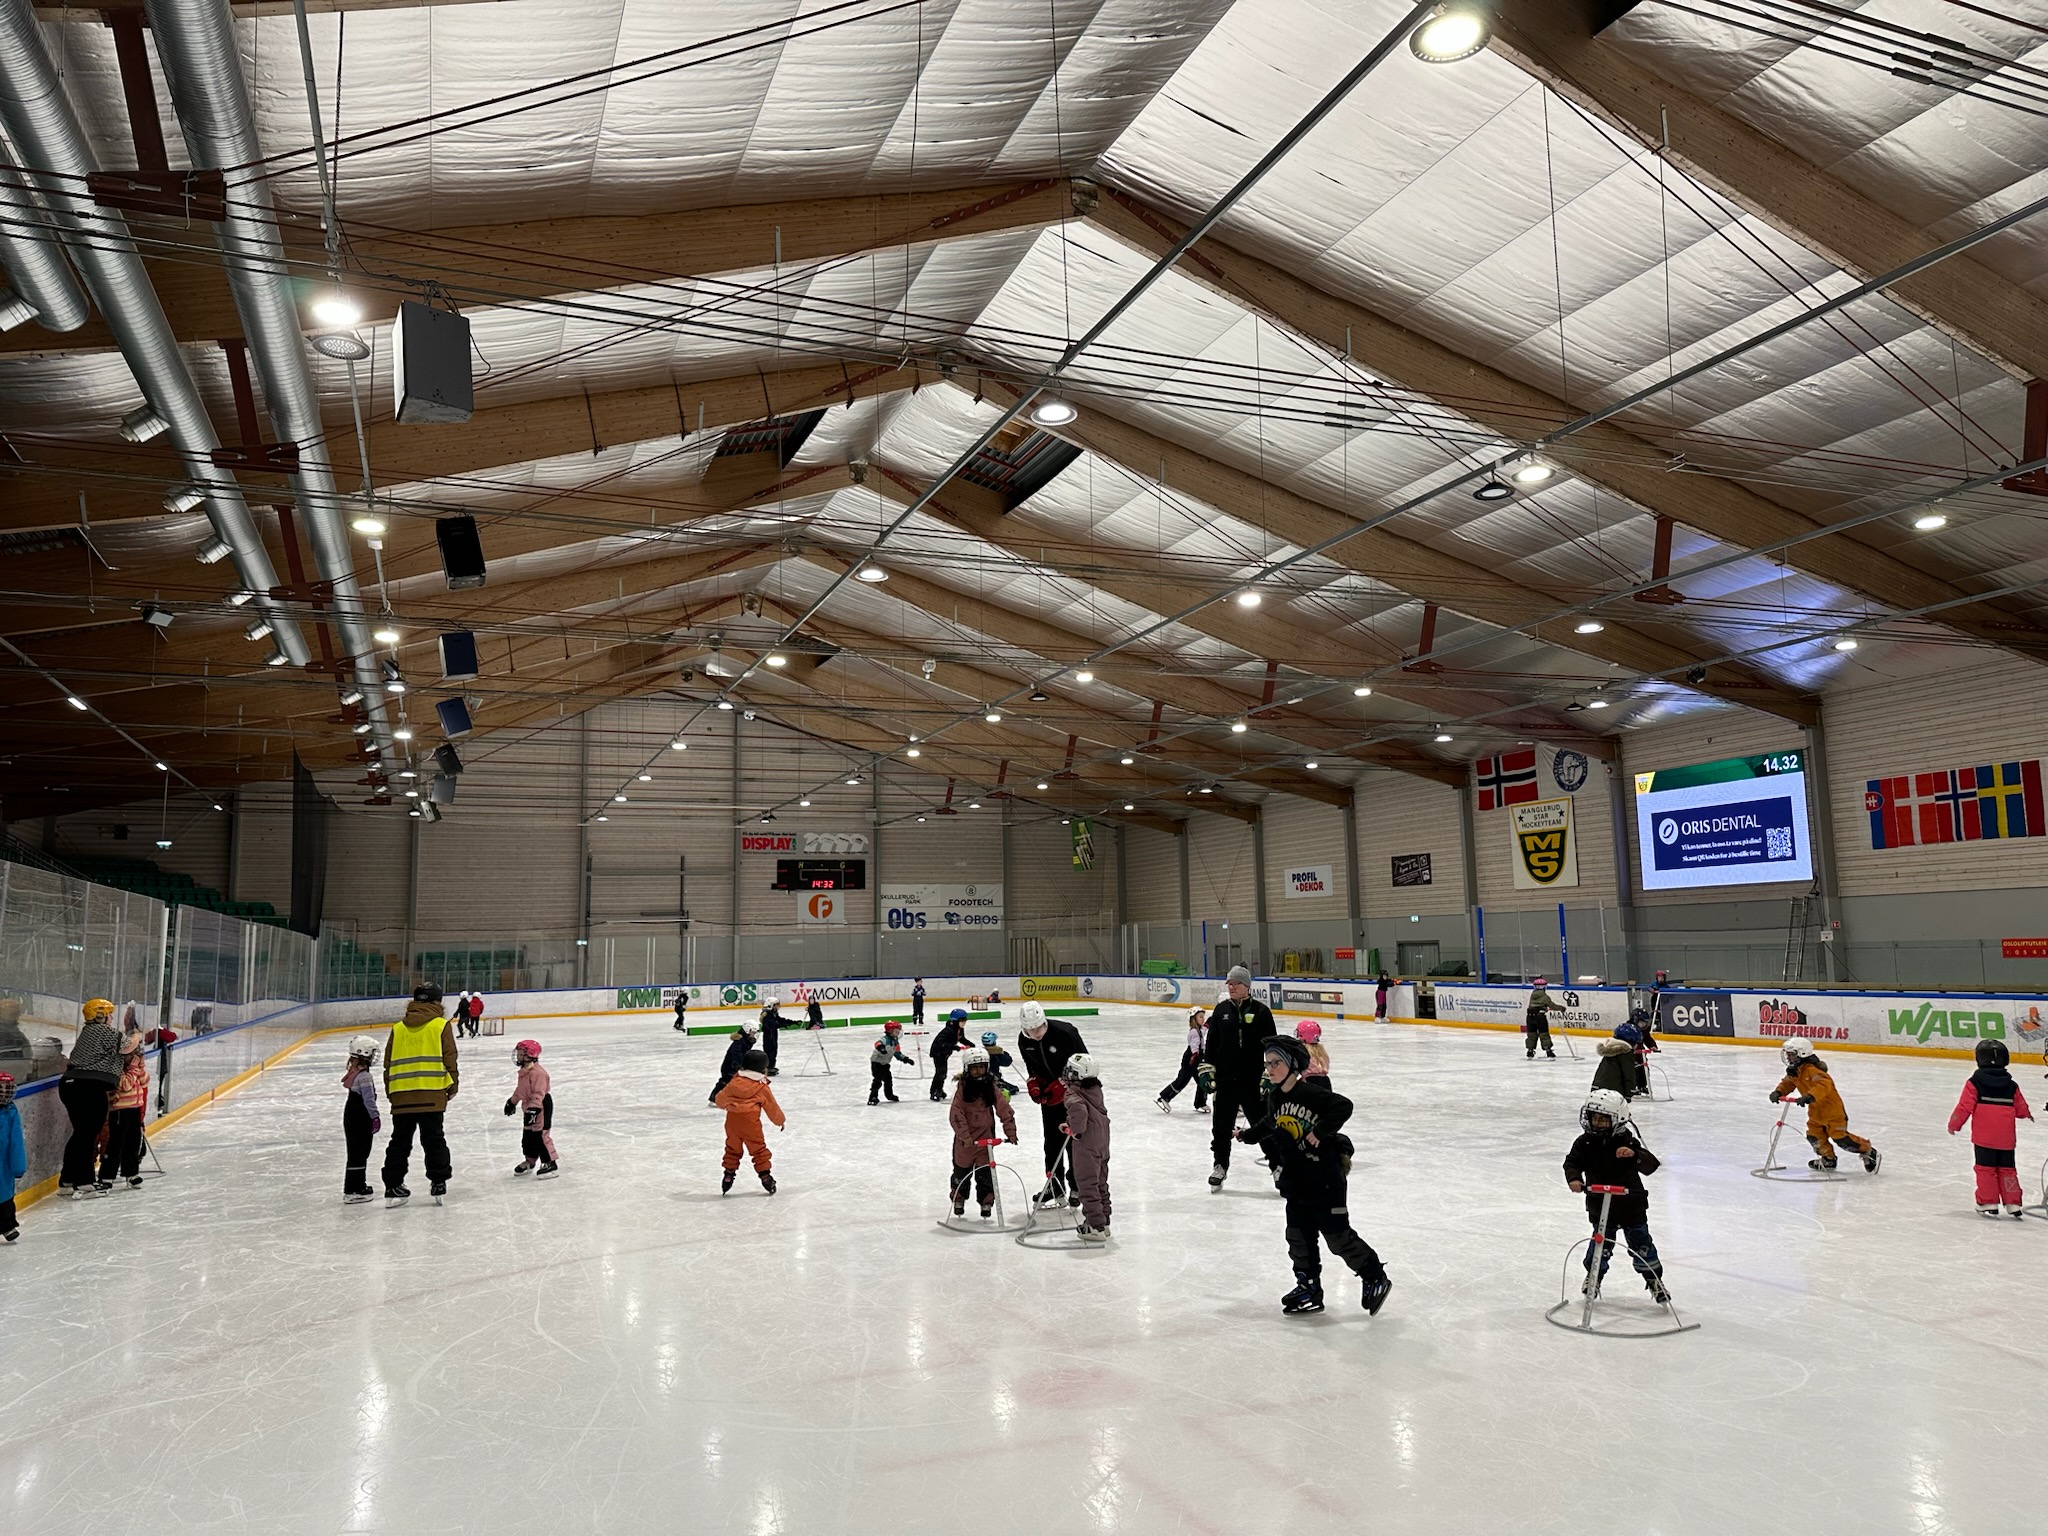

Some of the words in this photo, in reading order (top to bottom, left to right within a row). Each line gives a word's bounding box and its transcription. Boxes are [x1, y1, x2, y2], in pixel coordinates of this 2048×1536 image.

[1763, 754, 1799, 773] 14.32
[1520, 803, 1561, 815] MANGLERUD
[1533, 812, 1549, 821] STAR
[1521, 818, 1562, 829] HOCKEYTEAM
[1681, 819, 1711, 836] ORIS
[1712, 814, 1762, 833] DENTAL
[742, 837, 792, 850] DISPLAY
[1292, 871, 1318, 883] PROFIL
[812, 880, 834, 889] 14:32
[1300, 881, 1324, 892] DEKOR
[964, 914, 999, 925] OBOS
[1038, 984, 1078, 993] WARRIOR
[1147, 978, 1168, 992] Eltera
[617, 988, 661, 1009] KIWI
[812, 987, 861, 1001] MONIA
[1250, 988, 1268, 999] ANG
[1287, 991, 1314, 1001] OPTIMERA
[1439, 994, 1455, 1011] OAR
[1549, 1011, 1601, 1022] MANGLERUD
[1672, 1000, 1721, 1029] ecit
[1760, 1003, 1800, 1024] Oslo
[1563, 1021, 1588, 1029] SENTER
[1888, 1002, 2006, 1045] WAGO
[1759, 1023, 1833, 1039] ENTREPRENØR
[1835, 1027, 1850, 1040] AS
